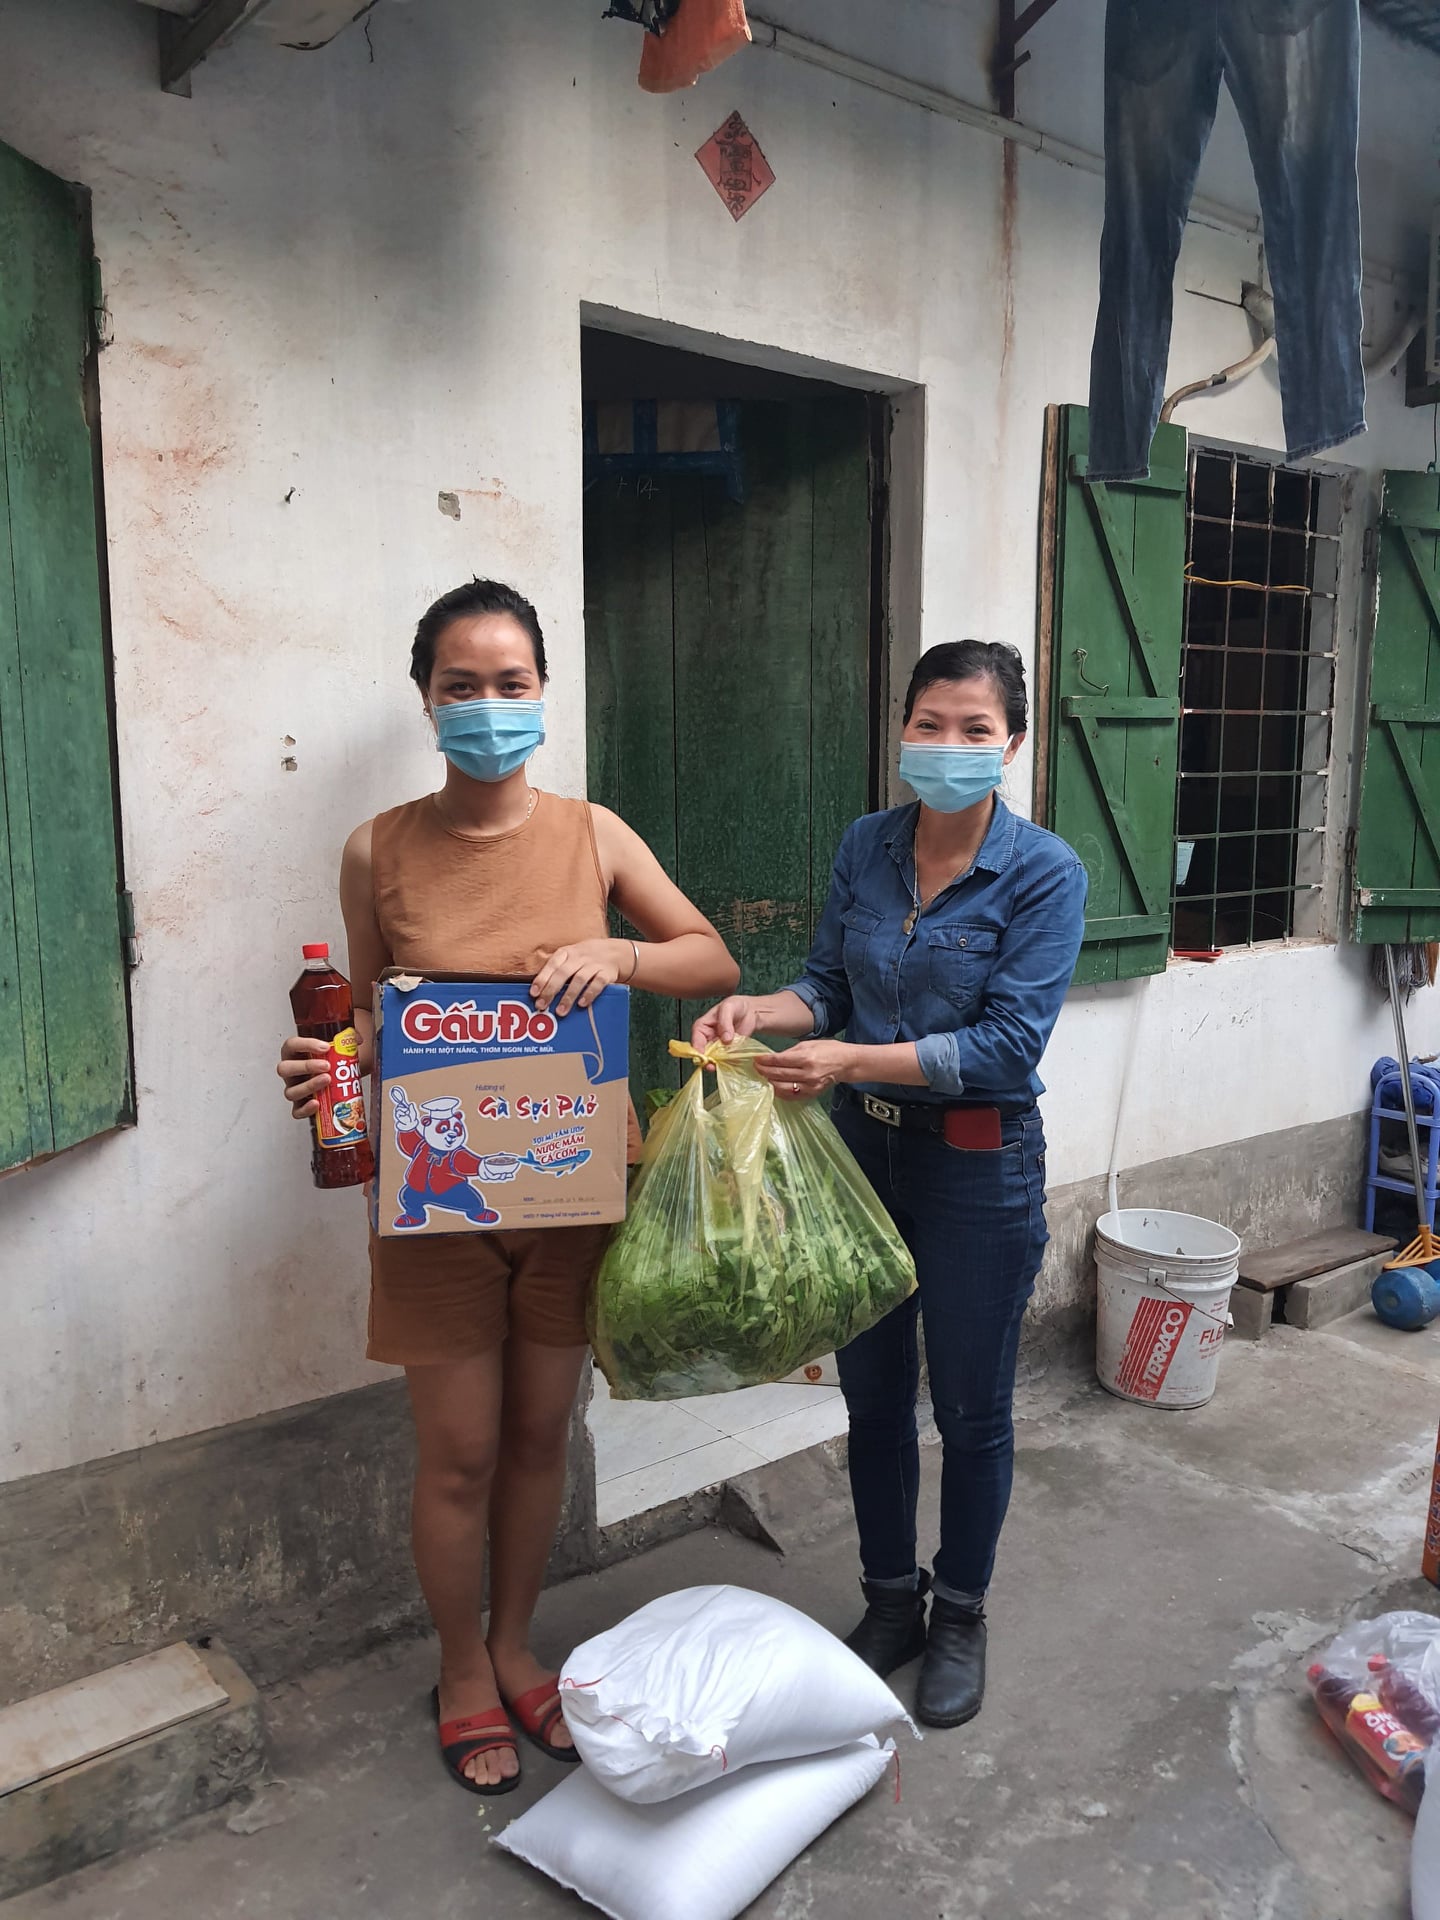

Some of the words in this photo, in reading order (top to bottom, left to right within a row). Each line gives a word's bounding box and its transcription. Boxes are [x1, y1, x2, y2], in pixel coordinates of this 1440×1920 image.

[402, 1000, 496, 1043] Gấu
[438, 1045, 454, 1055] MỘT
[478, 1095, 510, 1120] Gà
[516, 1094, 549, 1123] Sợi
[555, 1094, 598, 1119] Phở
[555, 1147, 578, 1160] CƠM
[1142, 1308, 1184, 1384] TERRACO
[1199, 1324, 1225, 1345] FLE
